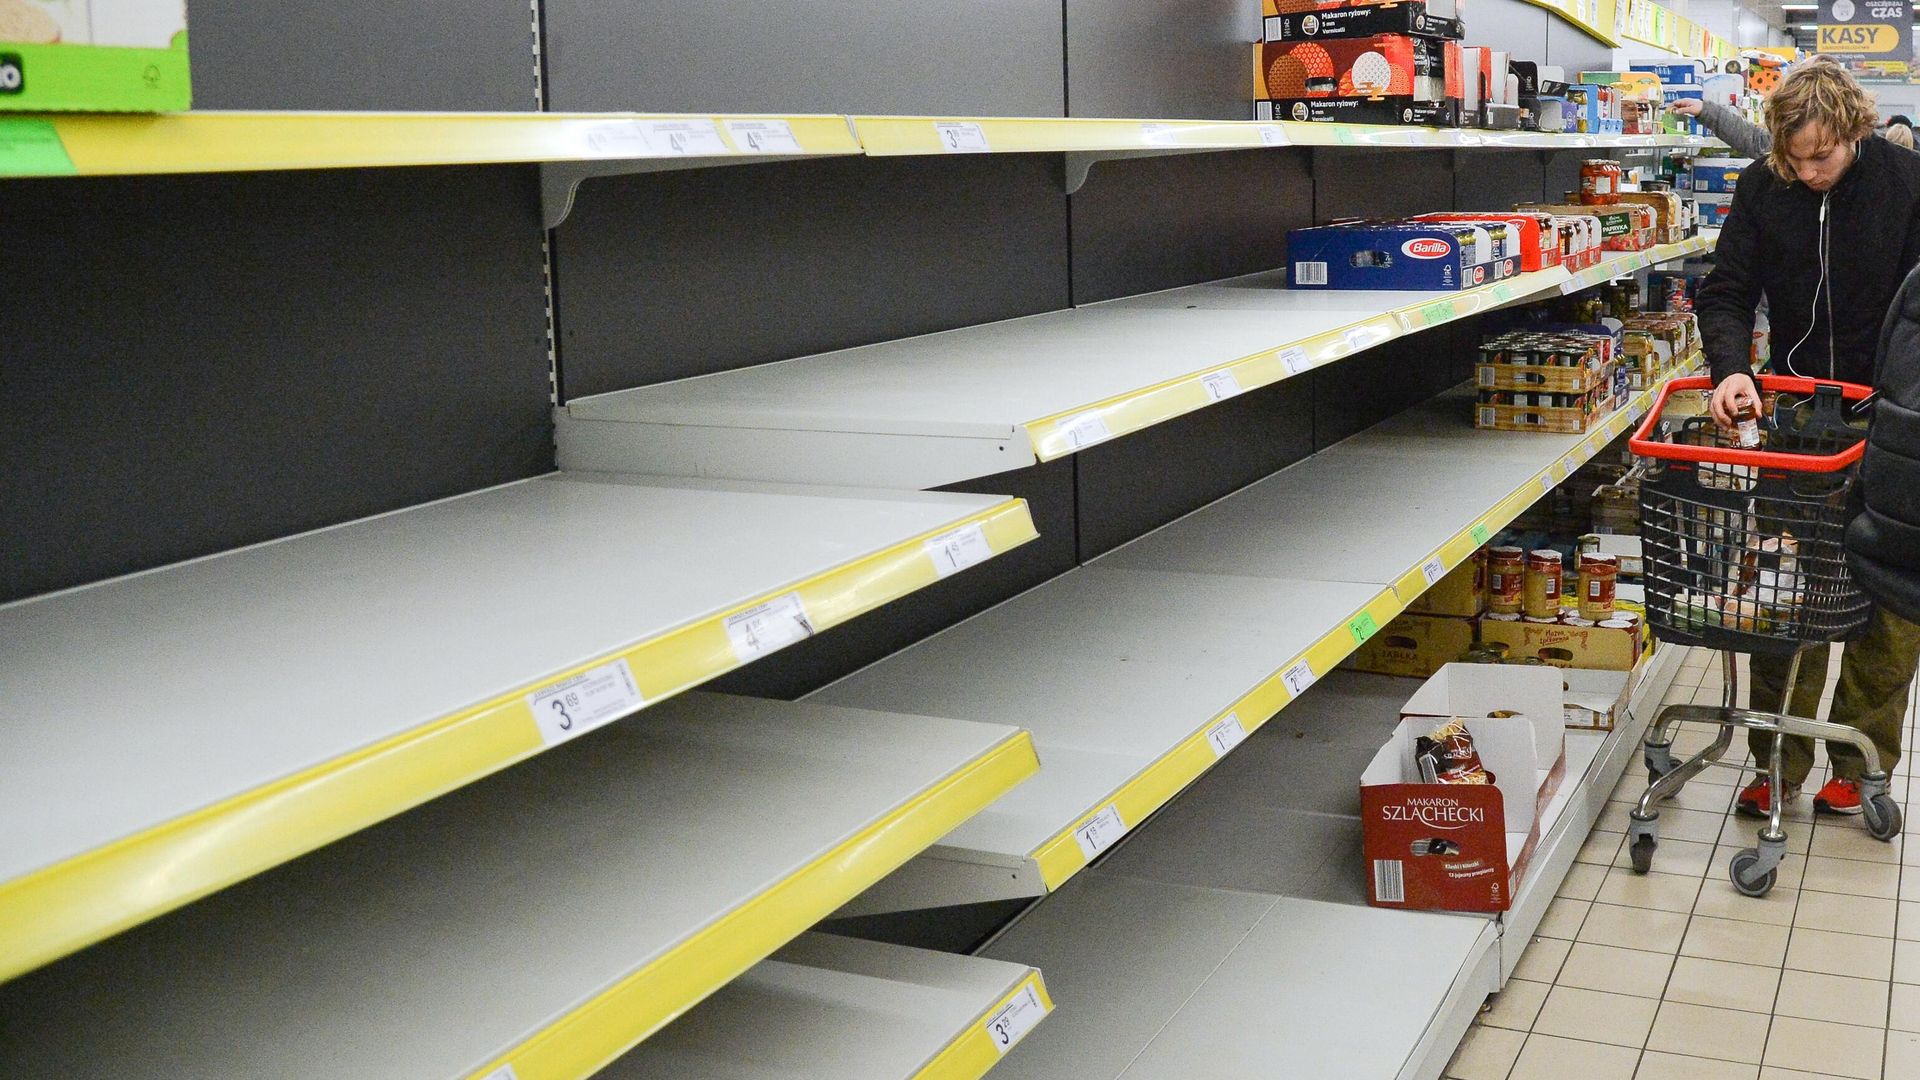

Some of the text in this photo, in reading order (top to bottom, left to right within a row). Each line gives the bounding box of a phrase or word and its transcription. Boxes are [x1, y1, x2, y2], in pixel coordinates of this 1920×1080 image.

[1321, 12, 1347, 20] Makaron
[1871, 8, 1903, 18] CZAS
[1822, 27, 1879, 44] KASY
[1602, 224, 1628, 233] PAPRYKA
[1413, 242, 1447, 253] Barilla
[552, 699, 572, 731] 3
[1407, 798, 1459, 807] MAKARON
[1382, 805, 1484, 823] SZLACHECKI
[995, 1023, 1009, 1045] 3
